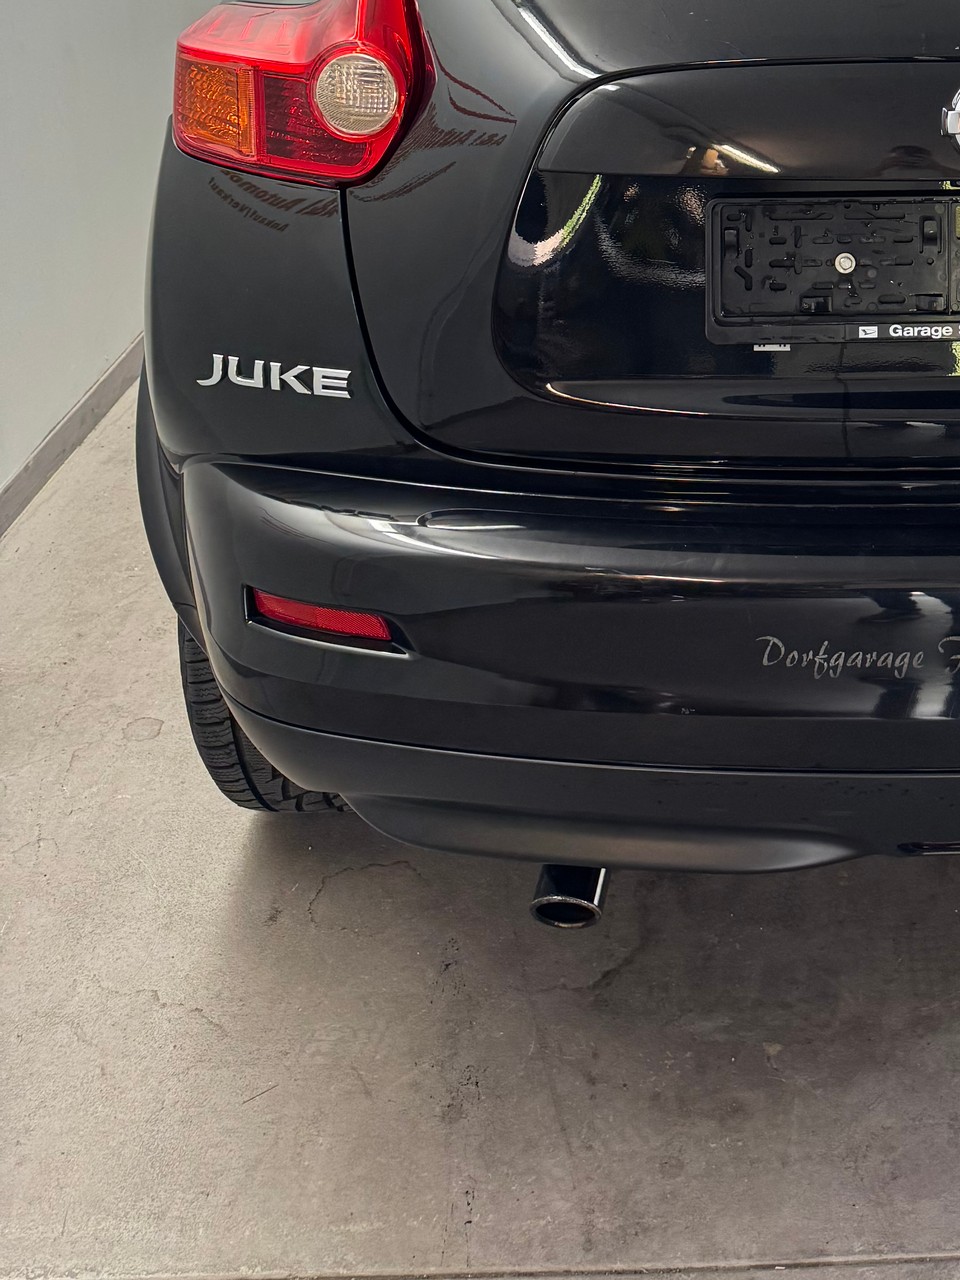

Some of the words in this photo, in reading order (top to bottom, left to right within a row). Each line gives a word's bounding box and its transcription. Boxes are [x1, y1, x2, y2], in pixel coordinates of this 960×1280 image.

[888, 323, 953, 339] Garage
[196, 353, 352, 399] JUKE
[755, 635, 924, 680] Dorfgarage
